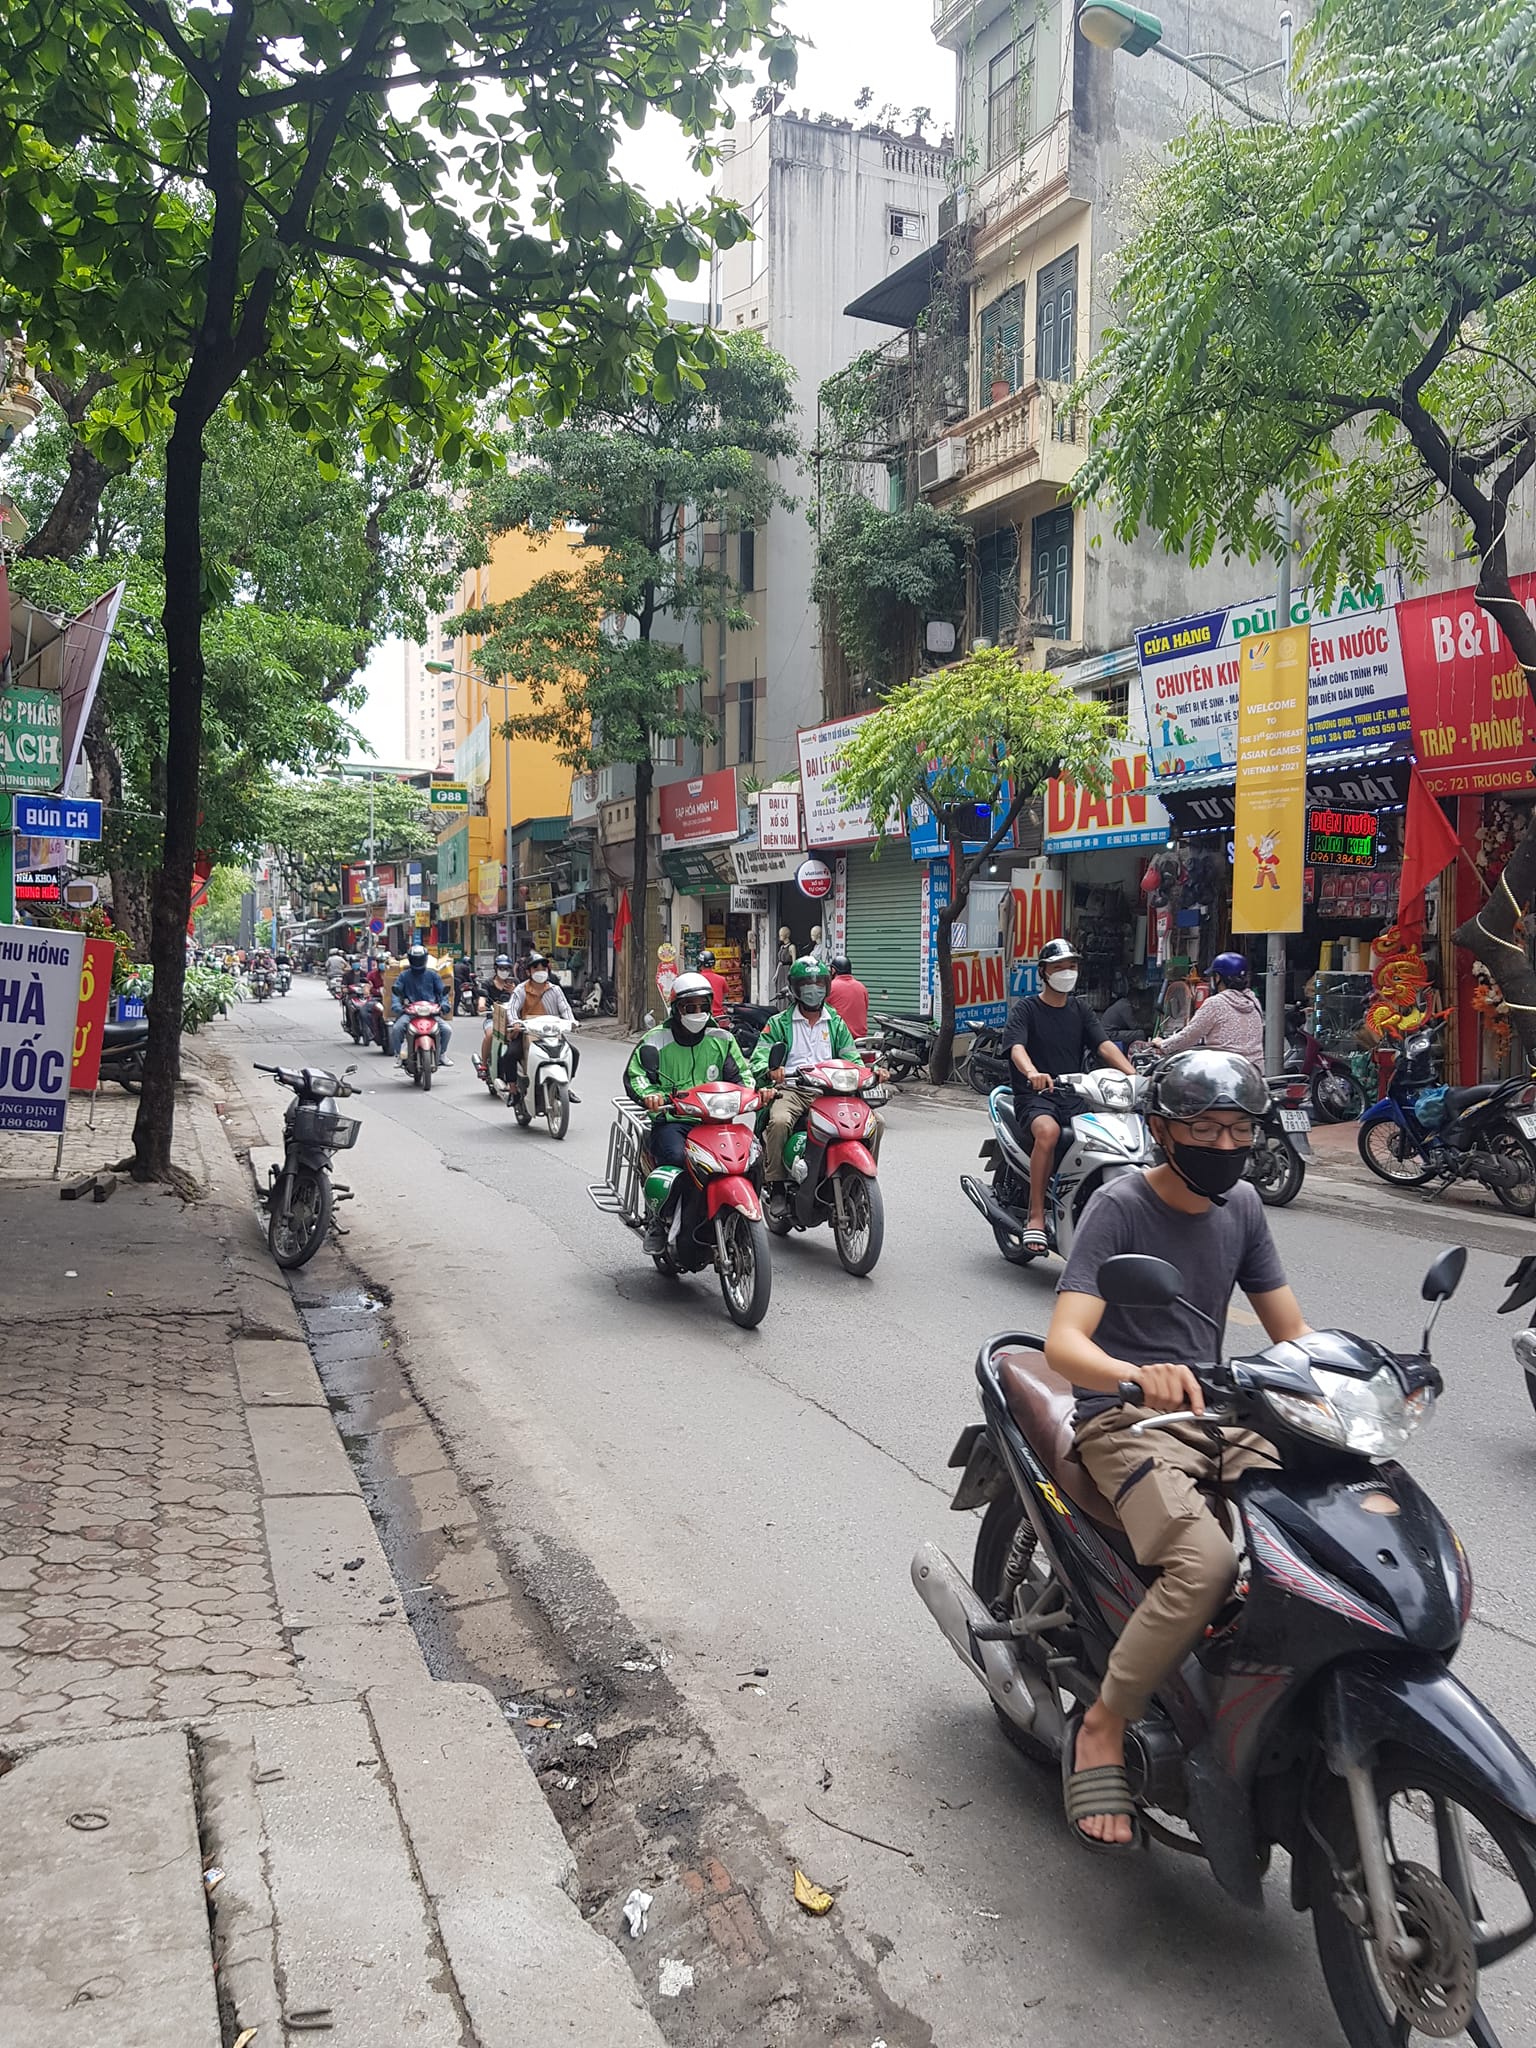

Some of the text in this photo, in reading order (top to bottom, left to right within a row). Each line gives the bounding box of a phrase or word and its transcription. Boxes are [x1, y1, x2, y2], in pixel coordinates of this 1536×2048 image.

[1144, 626, 1211, 655] CỬA HÀNG
[1156, 664, 1214, 700] CHUYÊN
[1339, 624, 1389, 661] NƯỚC
[1209, 697, 1224, 709] SINH
[1329, 670, 1349, 685] CÔNG
[1351, 667, 1372, 681] TRÌNH
[1354, 684, 1375, 700] DỤNG
[1247, 699, 1297, 715] WELCOME
[1266, 717, 1278, 726] TO
[1240, 735, 1252, 745] THE
[1265, 727, 1305, 742] SOUTHEAST
[1420, 721, 1457, 757] TRÁP
[1470, 713, 1524, 753] PHÔNG
[1240, 744, 1302, 761] ASIAN GAMES
[1242, 762, 1300, 776] VIETNAM 2021
[1449, 776, 1470, 792] 721
[768, 799, 780, 812] ĐẠI
[66, 809, 89, 829] CÁ
[1311, 810, 1343, 836] ĐIỆN
[780, 831, 797, 845] TOÁN
[1315, 834, 1344, 853] KIM
[1346, 835, 1372, 856] KHÍ
[1310, 853, 1373, 867] 0961 384 802
[27, 939, 70, 966] HỒNG
